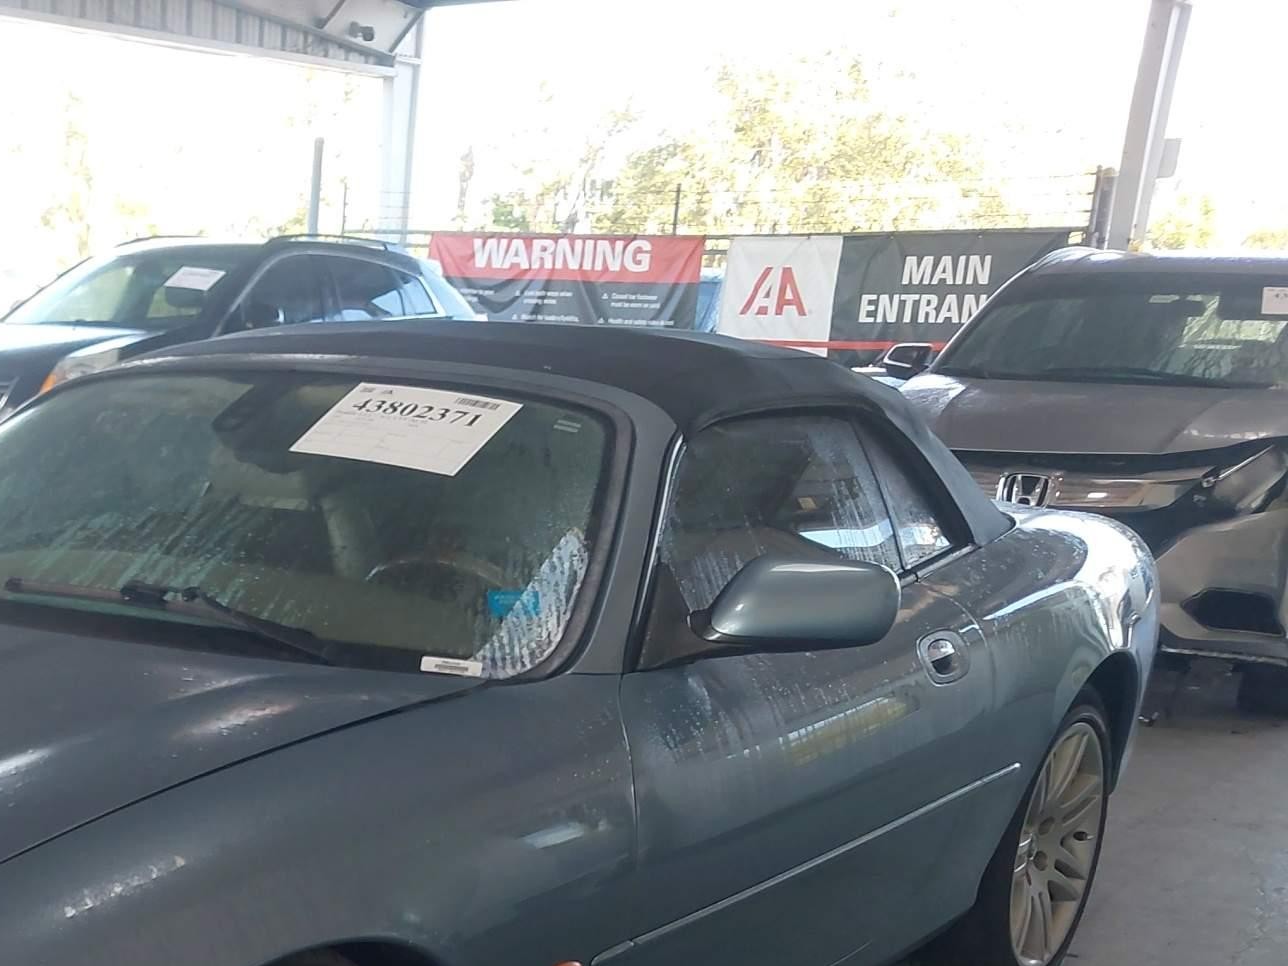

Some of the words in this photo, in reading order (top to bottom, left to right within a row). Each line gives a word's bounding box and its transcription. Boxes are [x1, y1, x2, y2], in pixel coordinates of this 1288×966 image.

[472, 238, 653, 273] WARNING
[901, 254, 993, 286] MAIN
[857, 294, 989, 324] ENTRAN
[351, 398, 483, 427] 43802371
